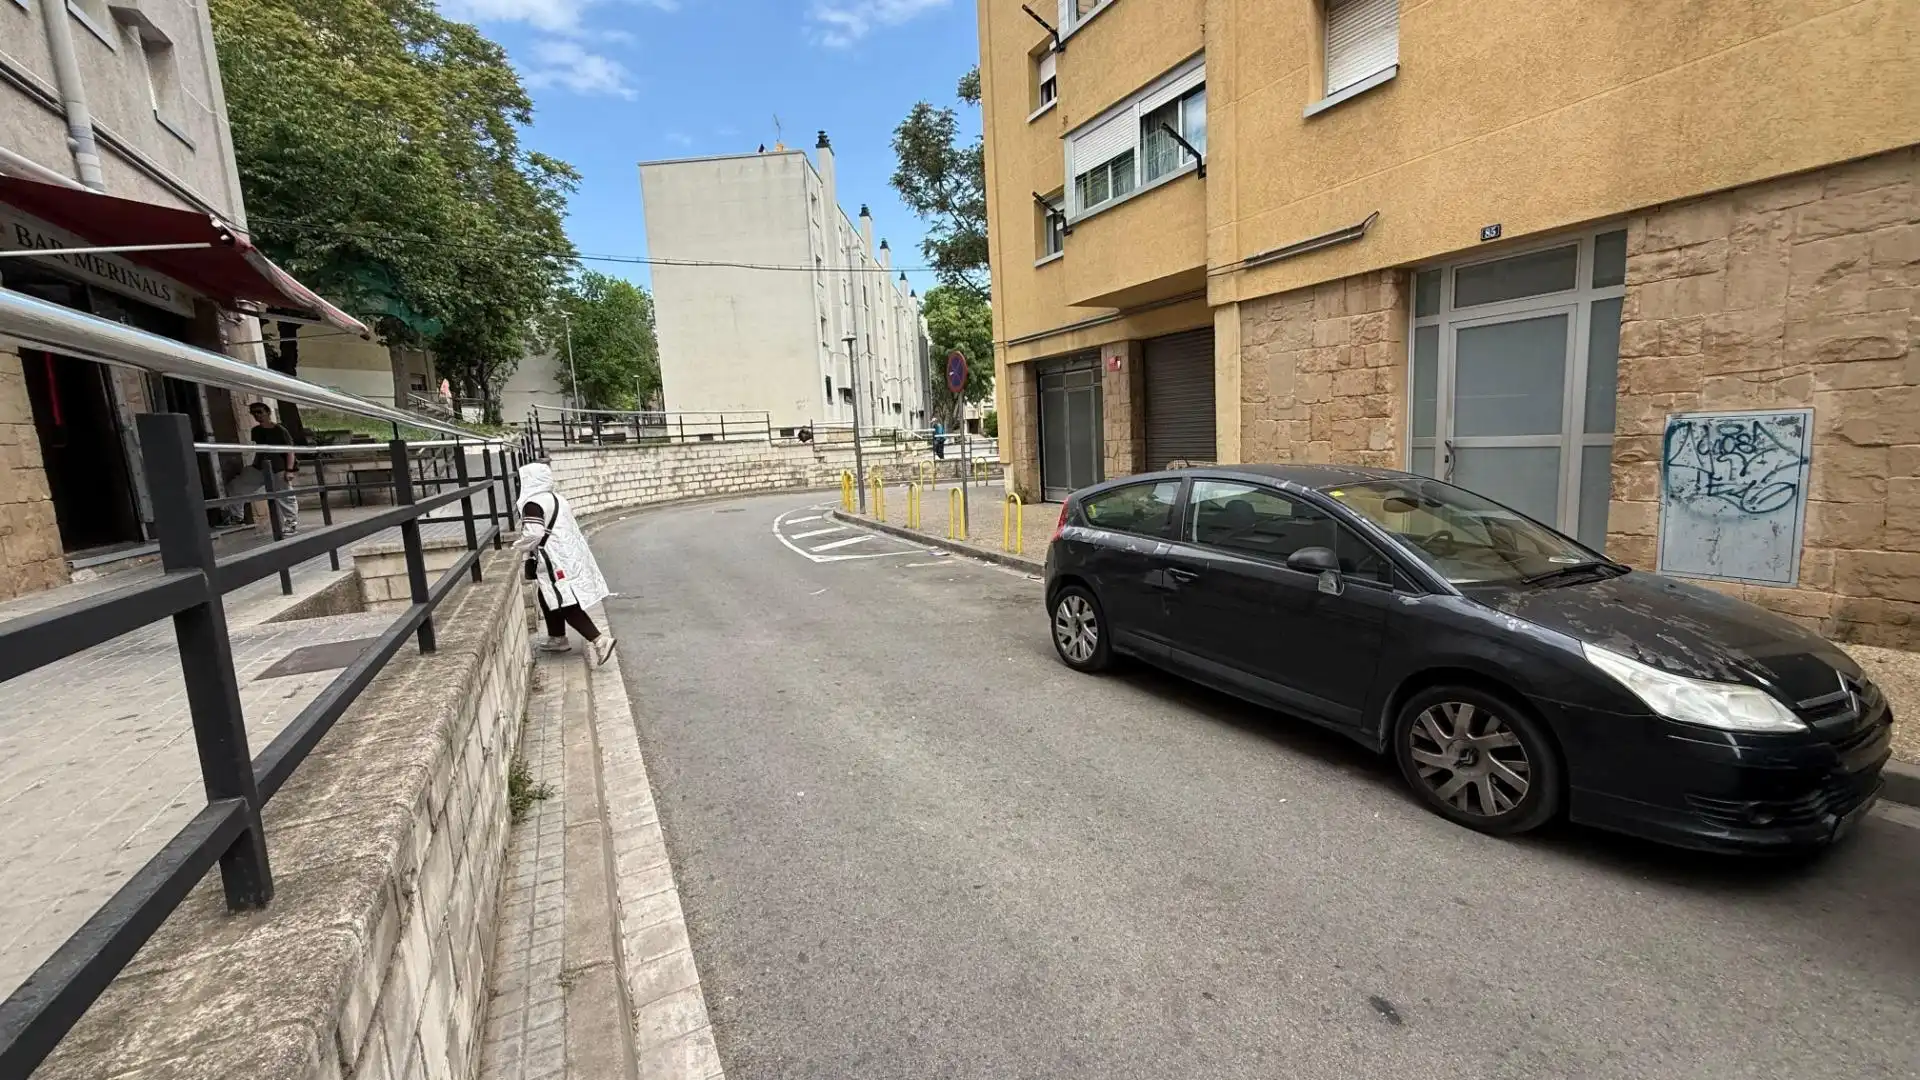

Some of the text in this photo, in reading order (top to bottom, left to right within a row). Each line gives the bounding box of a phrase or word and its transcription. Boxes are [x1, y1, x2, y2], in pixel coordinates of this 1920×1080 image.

[1484, 225, 1497, 239] 85
[13, 222, 171, 302] BAR MERINALS
